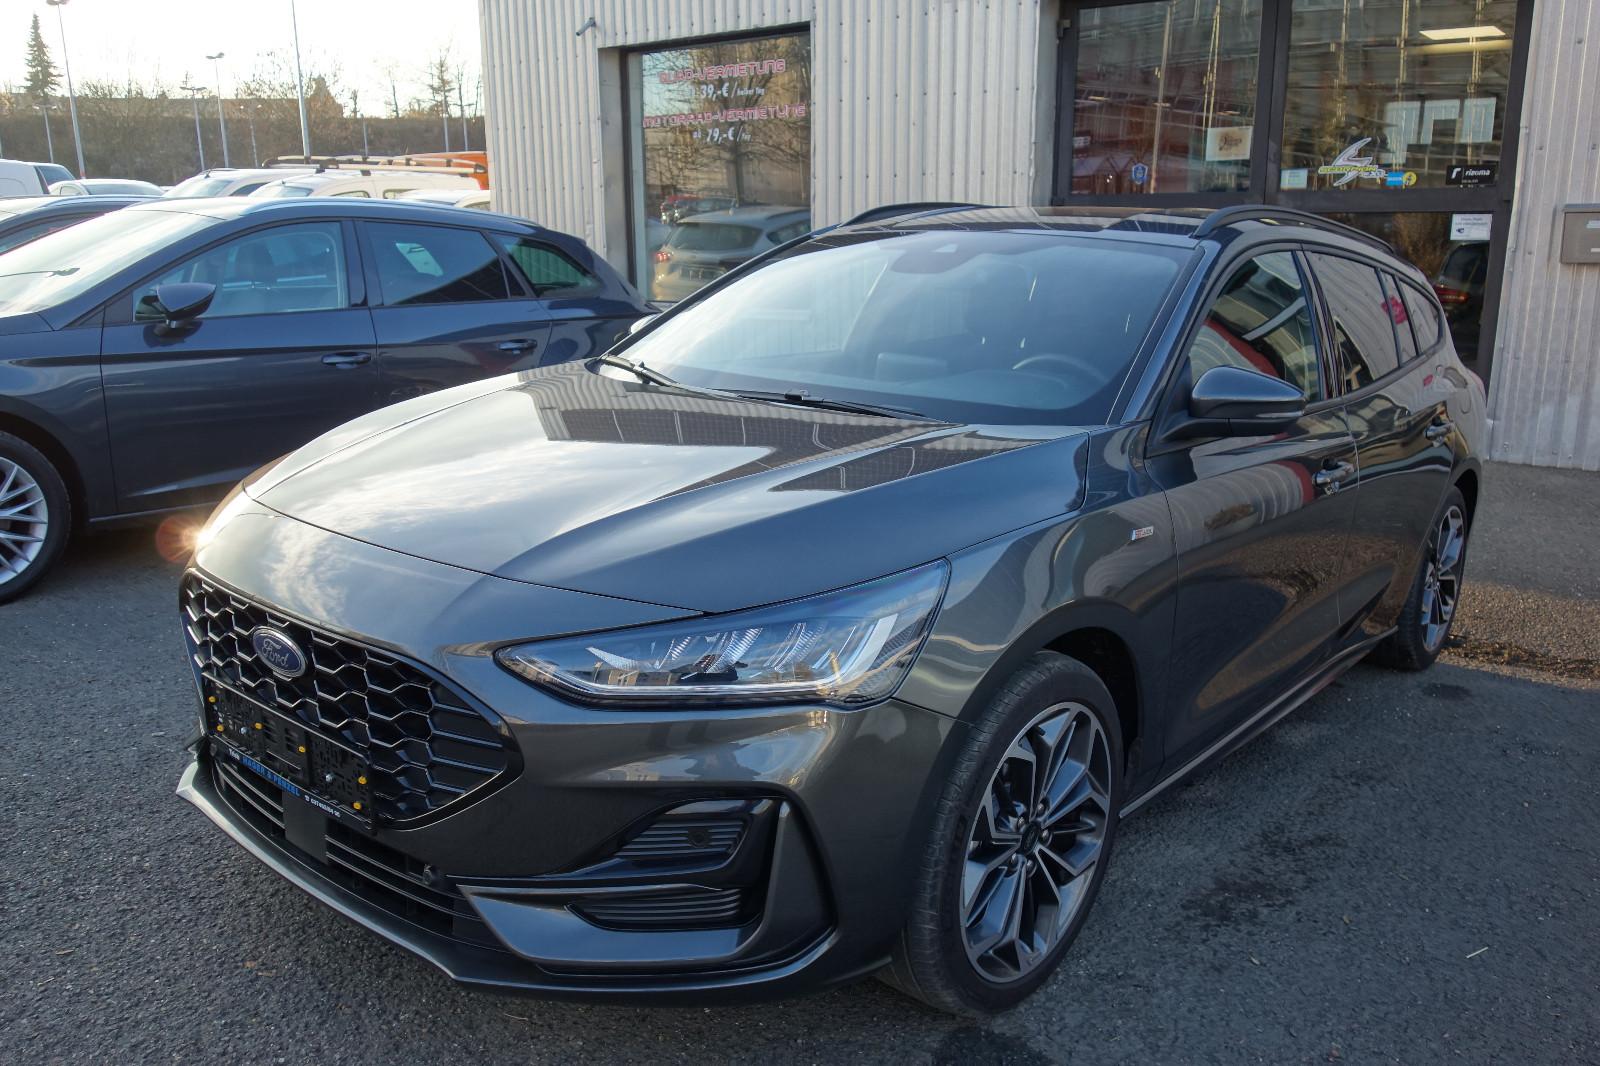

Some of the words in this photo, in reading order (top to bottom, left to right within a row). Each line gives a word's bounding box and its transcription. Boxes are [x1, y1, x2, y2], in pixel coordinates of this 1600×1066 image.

[658, 58, 787, 85] QUAD-VERMIETUNG
[642, 102, 807, 129] MOTORRAD-VERMIETUNG
[1465, 168, 1491, 176] rizoma
[262, 638, 290, 667] Ford
